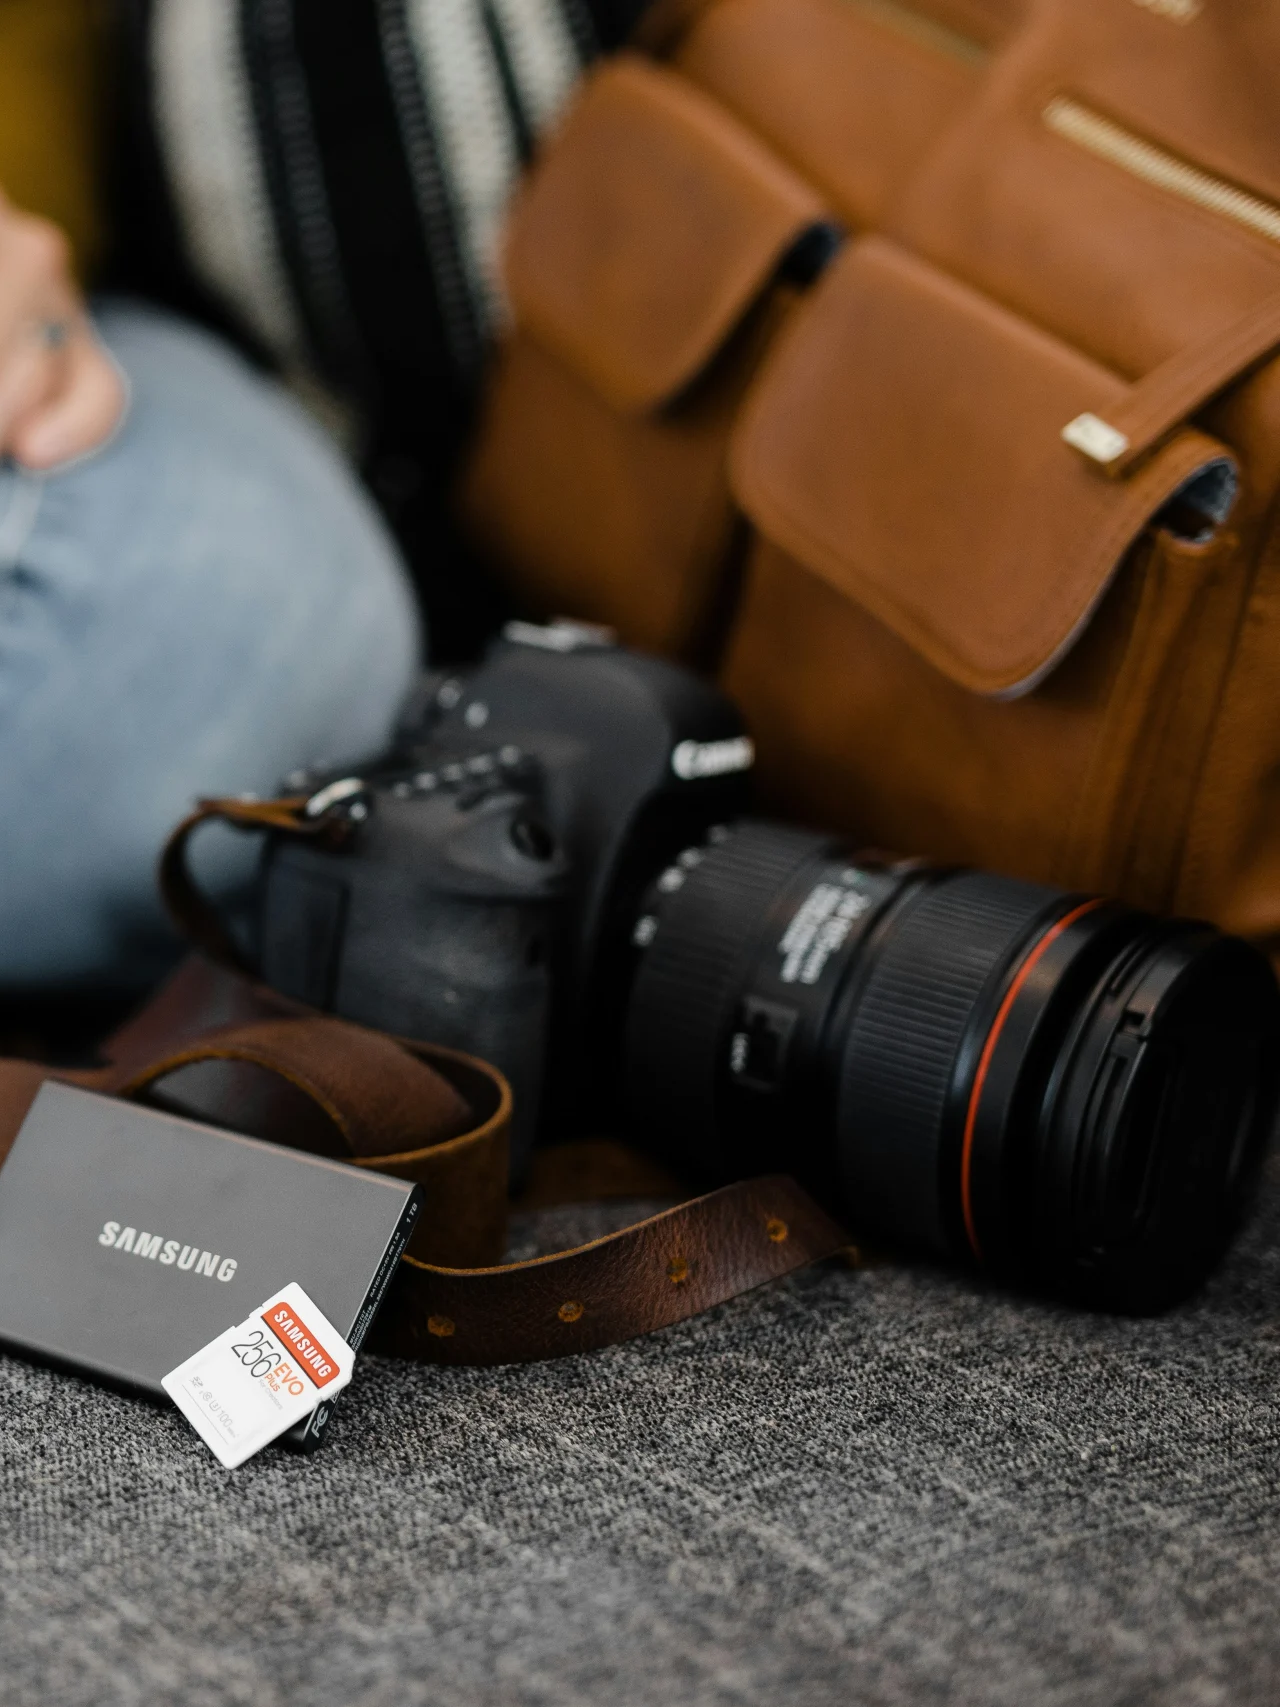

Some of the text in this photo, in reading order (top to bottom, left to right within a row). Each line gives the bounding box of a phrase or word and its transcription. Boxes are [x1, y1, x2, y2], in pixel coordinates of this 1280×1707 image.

[409, 1202, 418, 1216] TB
[98, 1221, 238, 1282] SAMSUNG
[231, 1330, 282, 1378] 256
[273, 1310, 332, 1378] SAMSUNG
[264, 1373, 281, 1392] Plus
[273, 1362, 304, 1395] EVO
